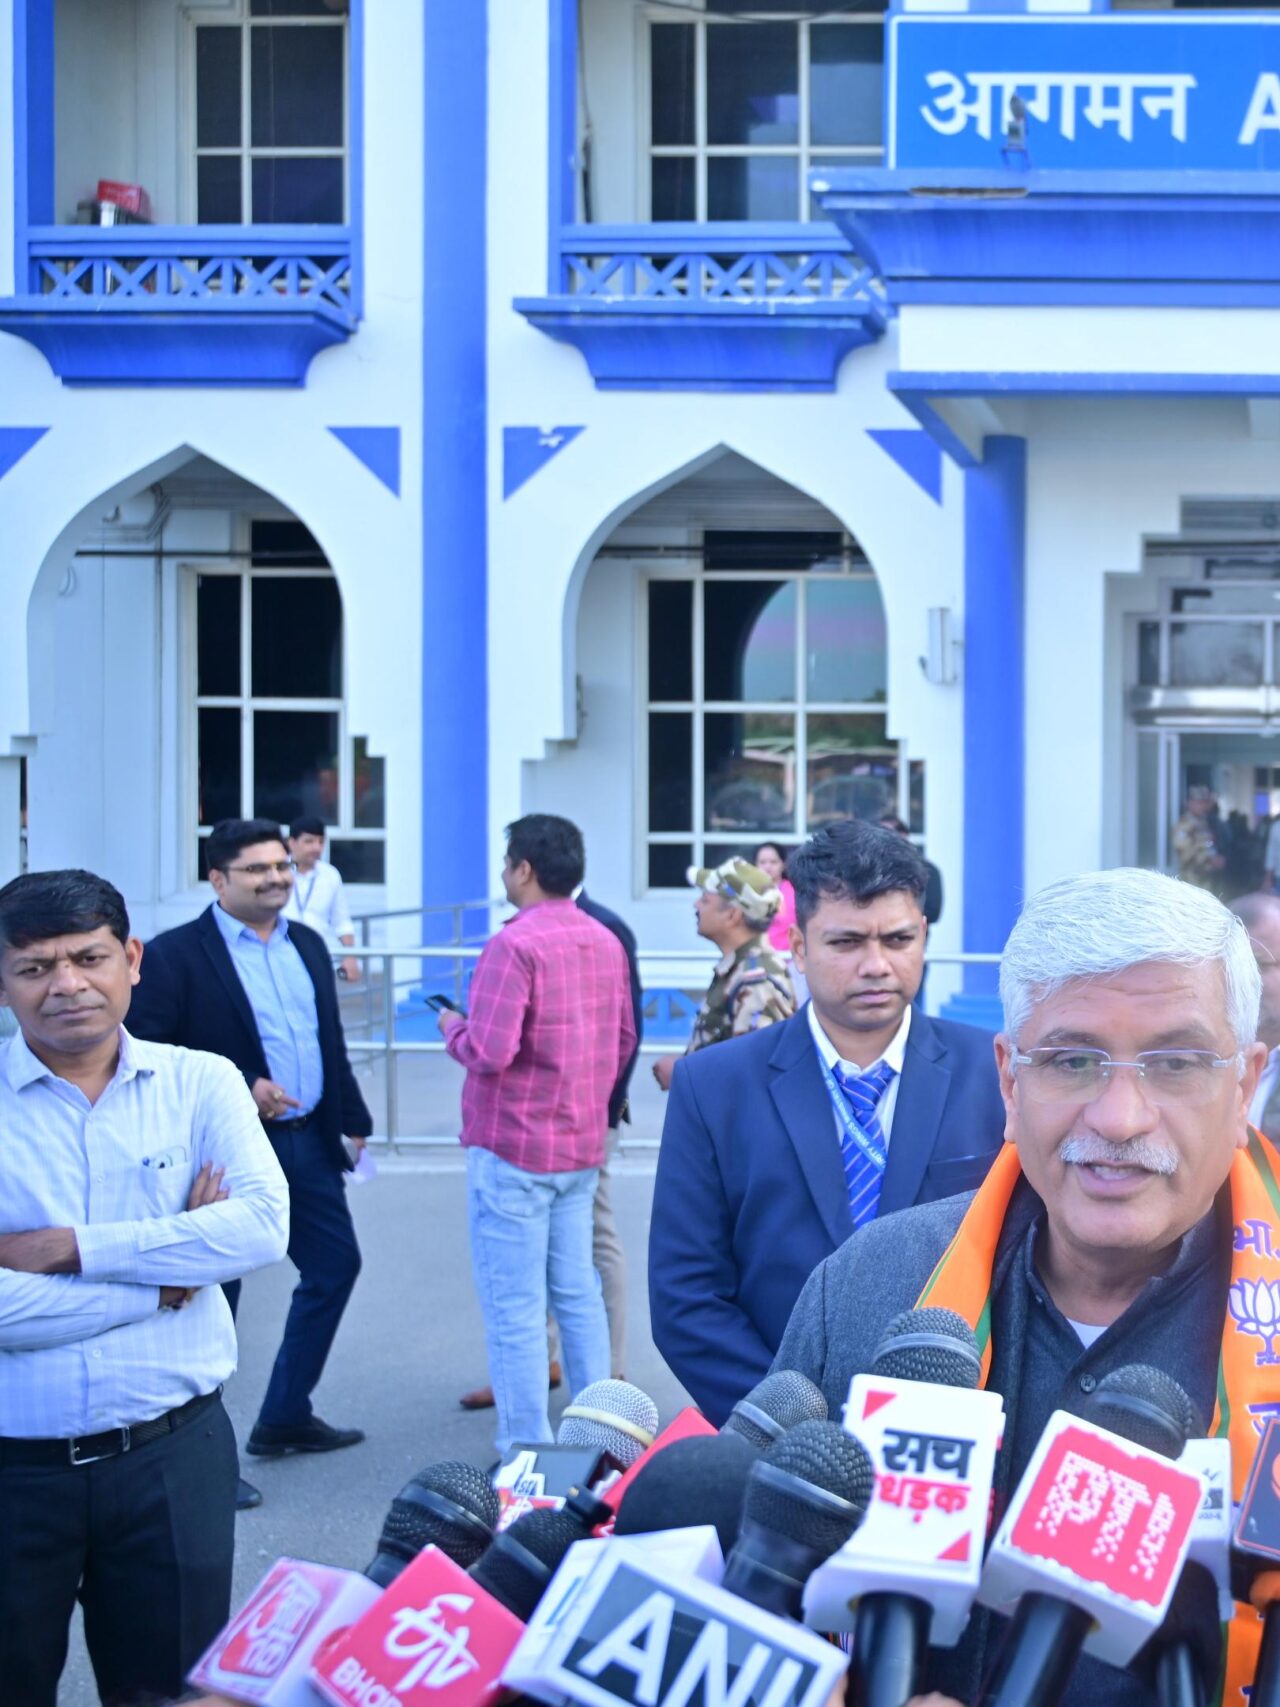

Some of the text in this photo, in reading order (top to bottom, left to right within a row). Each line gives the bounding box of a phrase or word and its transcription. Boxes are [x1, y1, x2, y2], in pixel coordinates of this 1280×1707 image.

[918, 70, 1198, 142] आगमन
[882, 1428, 977, 1480] सच
[875, 1473, 972, 1524] धड़क
[1034, 1450, 1177, 1581] PTI
[575, 1589, 805, 1707] ANI
